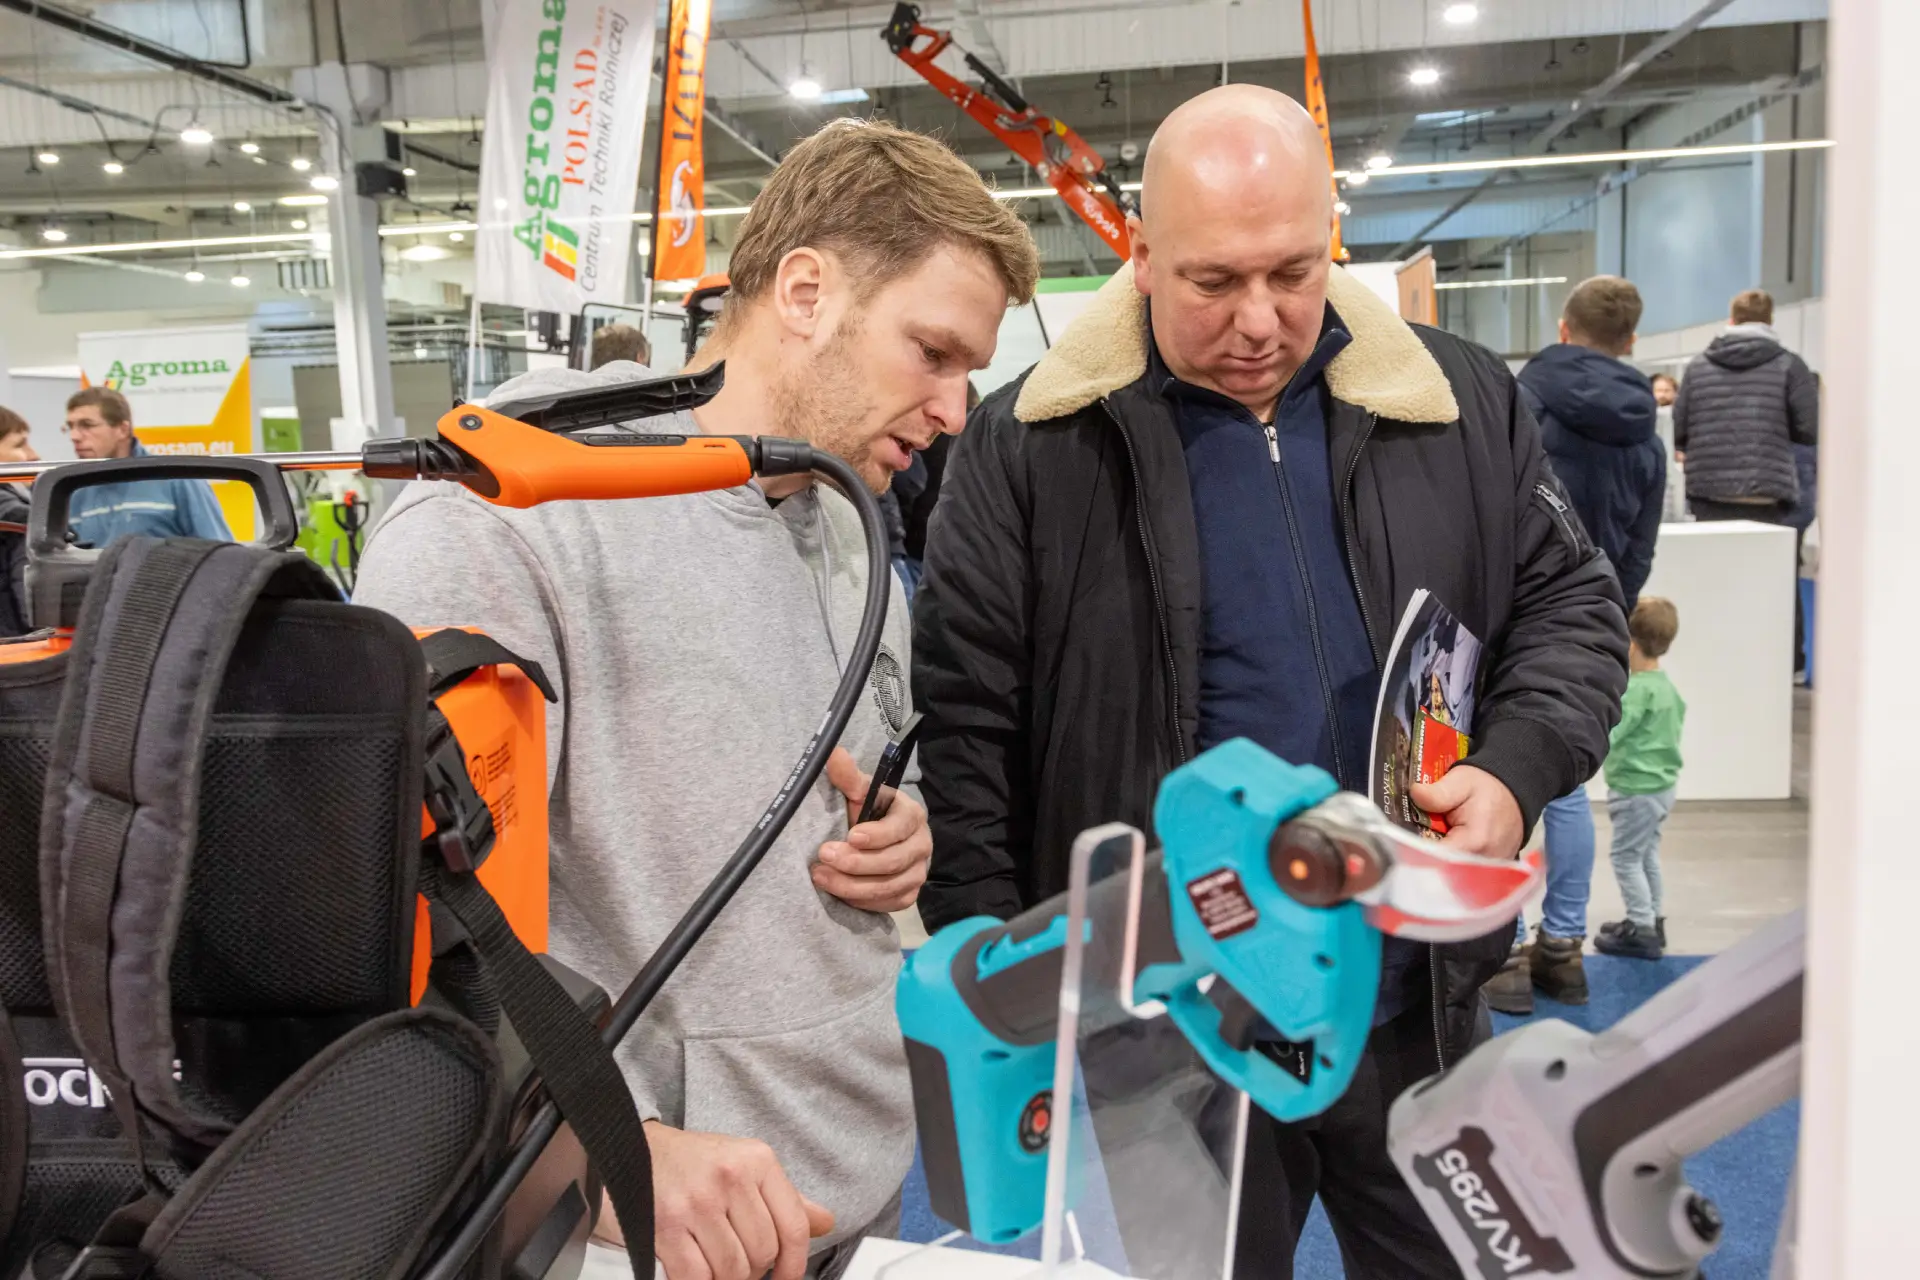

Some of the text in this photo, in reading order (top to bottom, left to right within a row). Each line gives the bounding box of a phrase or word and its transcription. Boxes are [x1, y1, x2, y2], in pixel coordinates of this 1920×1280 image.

[600, 9, 630, 109] Rolniczej
[562, 47, 598, 186] POLSAD
[588, 112, 615, 197] Techniki
[580, 204, 603, 293] Centrum
[105, 360, 230, 387] Agroma
[1434, 1149, 1533, 1273] KV295
